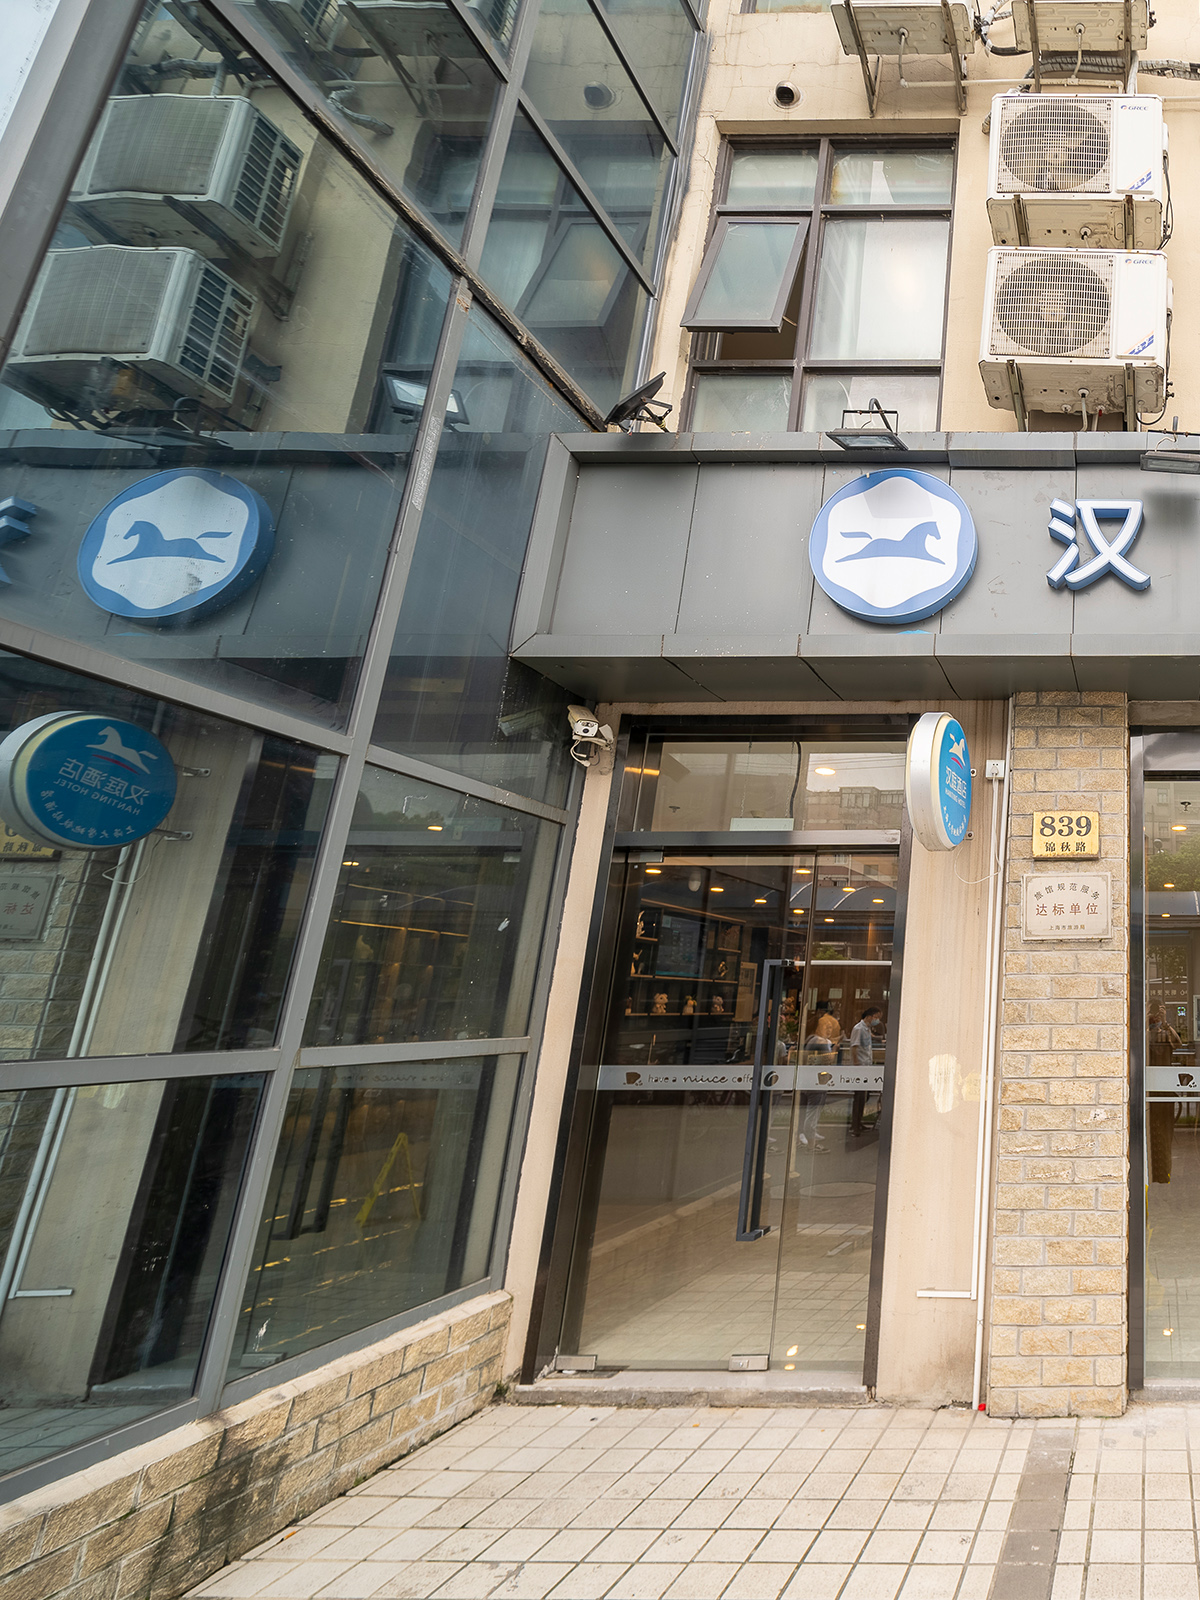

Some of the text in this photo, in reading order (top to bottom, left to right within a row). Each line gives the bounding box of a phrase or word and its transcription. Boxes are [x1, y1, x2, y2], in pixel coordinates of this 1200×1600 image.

[1040, 816, 1092, 837] 839
[1045, 841, 1086, 852] 锦秋路
[1034, 882, 1100, 901] 旅馆规范服务
[1035, 902, 1099, 916] 达标单位
[648, 1074, 669, 1083] have
[732, 1074, 753, 1083] coffe
[840, 1075, 862, 1083] have
